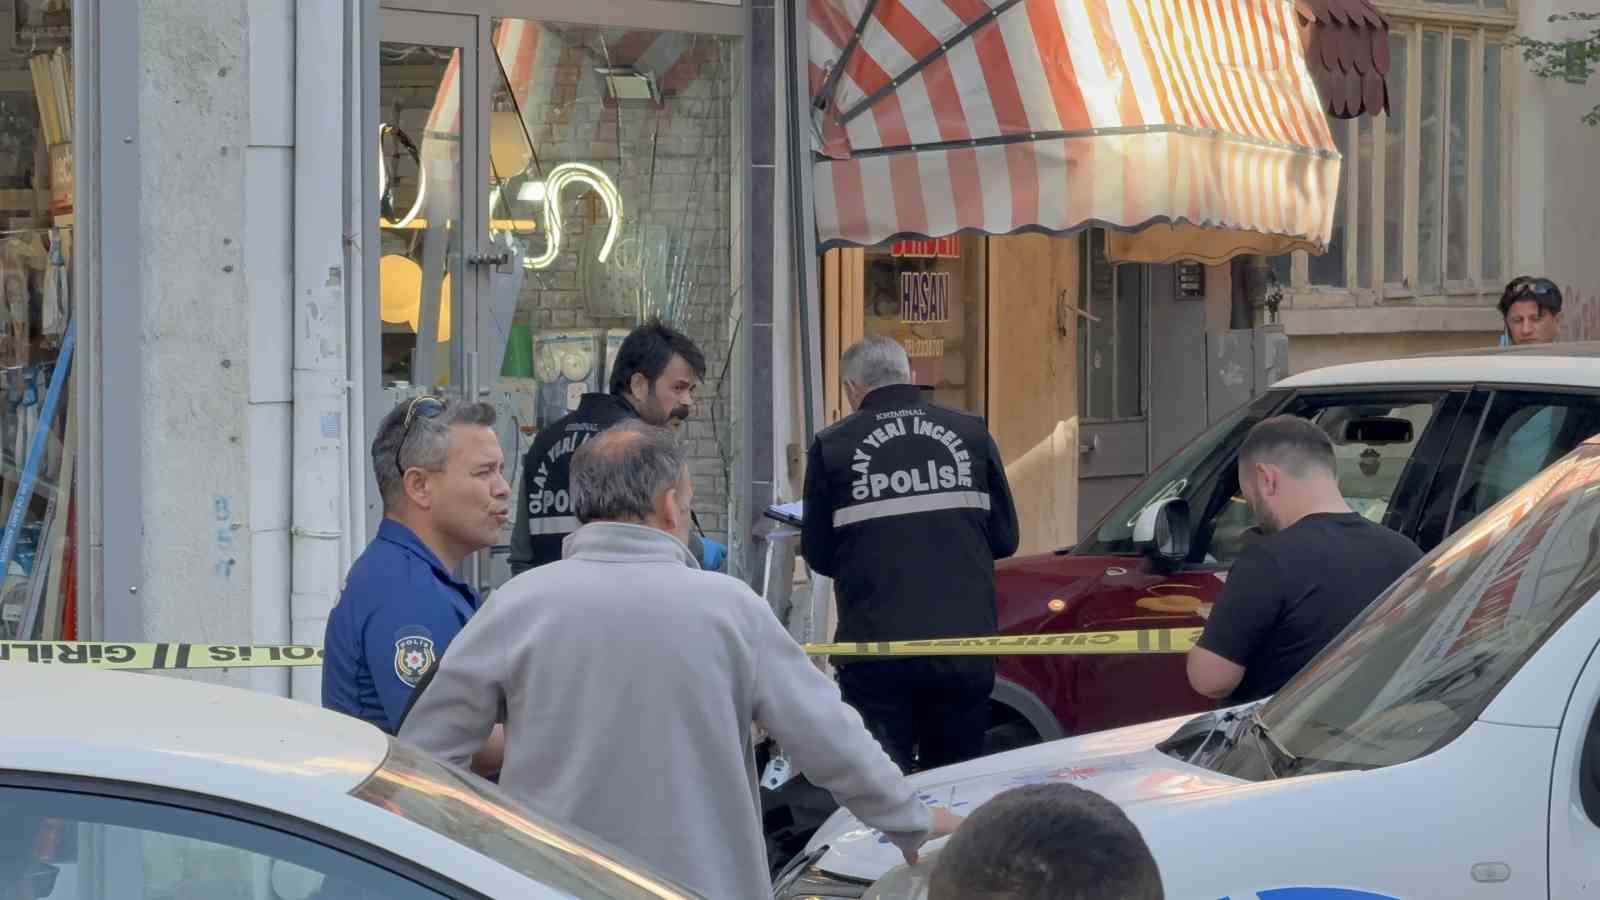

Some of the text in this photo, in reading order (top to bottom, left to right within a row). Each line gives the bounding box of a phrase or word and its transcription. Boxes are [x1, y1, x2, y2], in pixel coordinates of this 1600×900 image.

[900, 271, 950, 324] HASAN
[851, 416, 972, 500] OLAY YERİ İNCELEME
[870, 460, 956, 498] POLİS
[529, 461, 549, 514] OLAY
